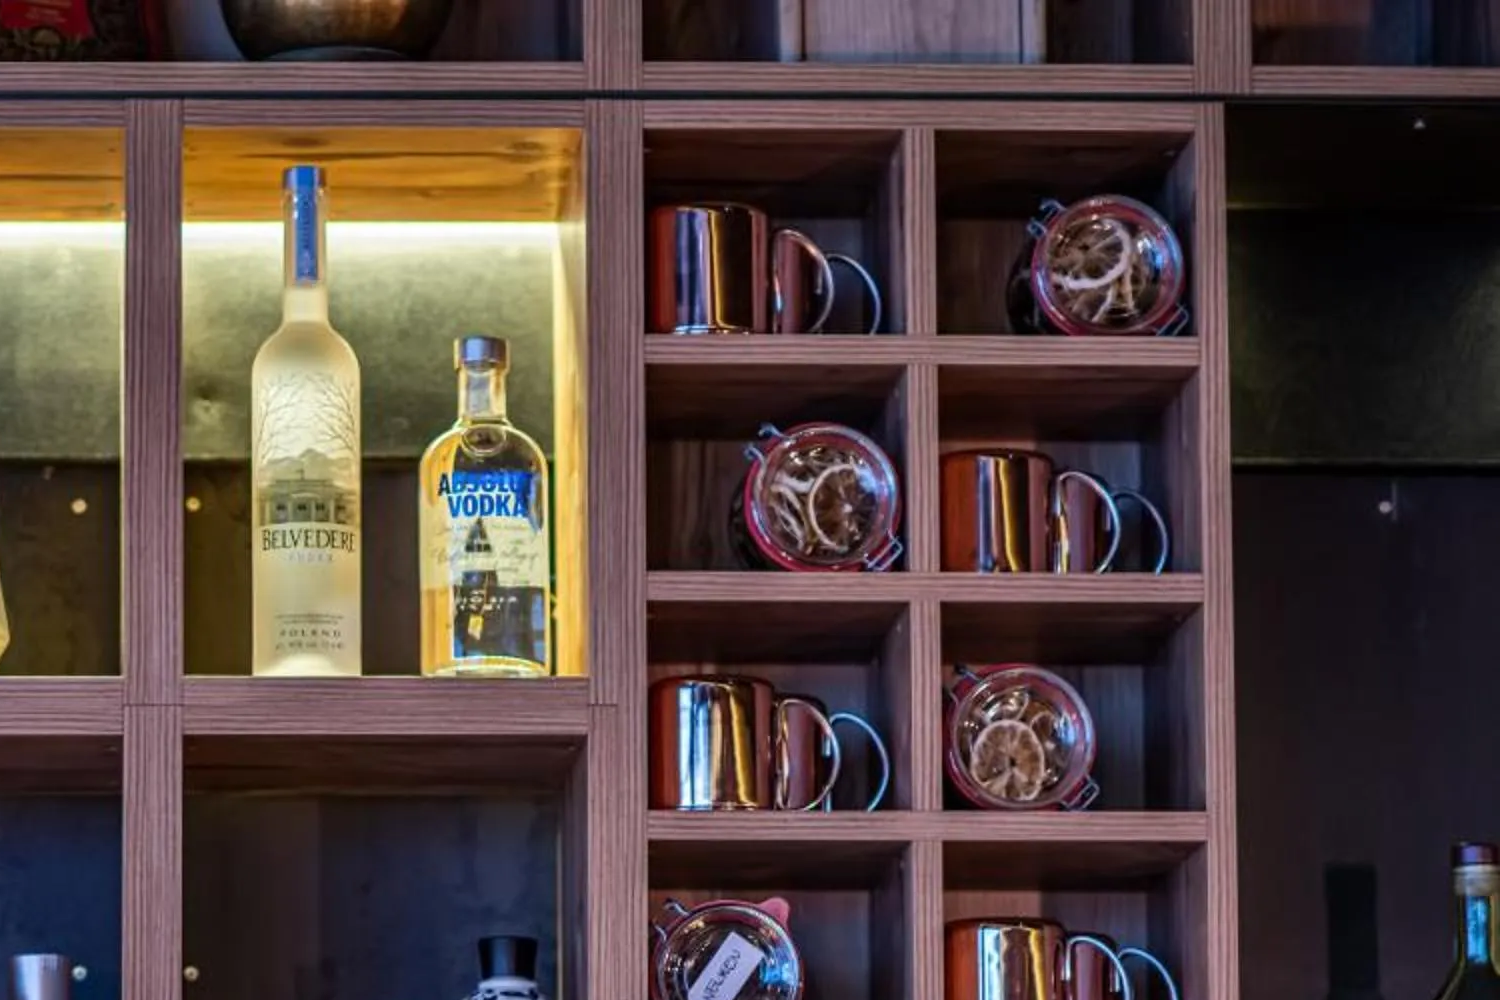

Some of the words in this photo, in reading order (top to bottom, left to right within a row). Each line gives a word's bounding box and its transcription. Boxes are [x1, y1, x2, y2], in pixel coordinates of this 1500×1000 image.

[438, 471, 532, 497] ABSOLU
[448, 493, 530, 518] VODKA
[261, 527, 356, 553] BELVEDERE
